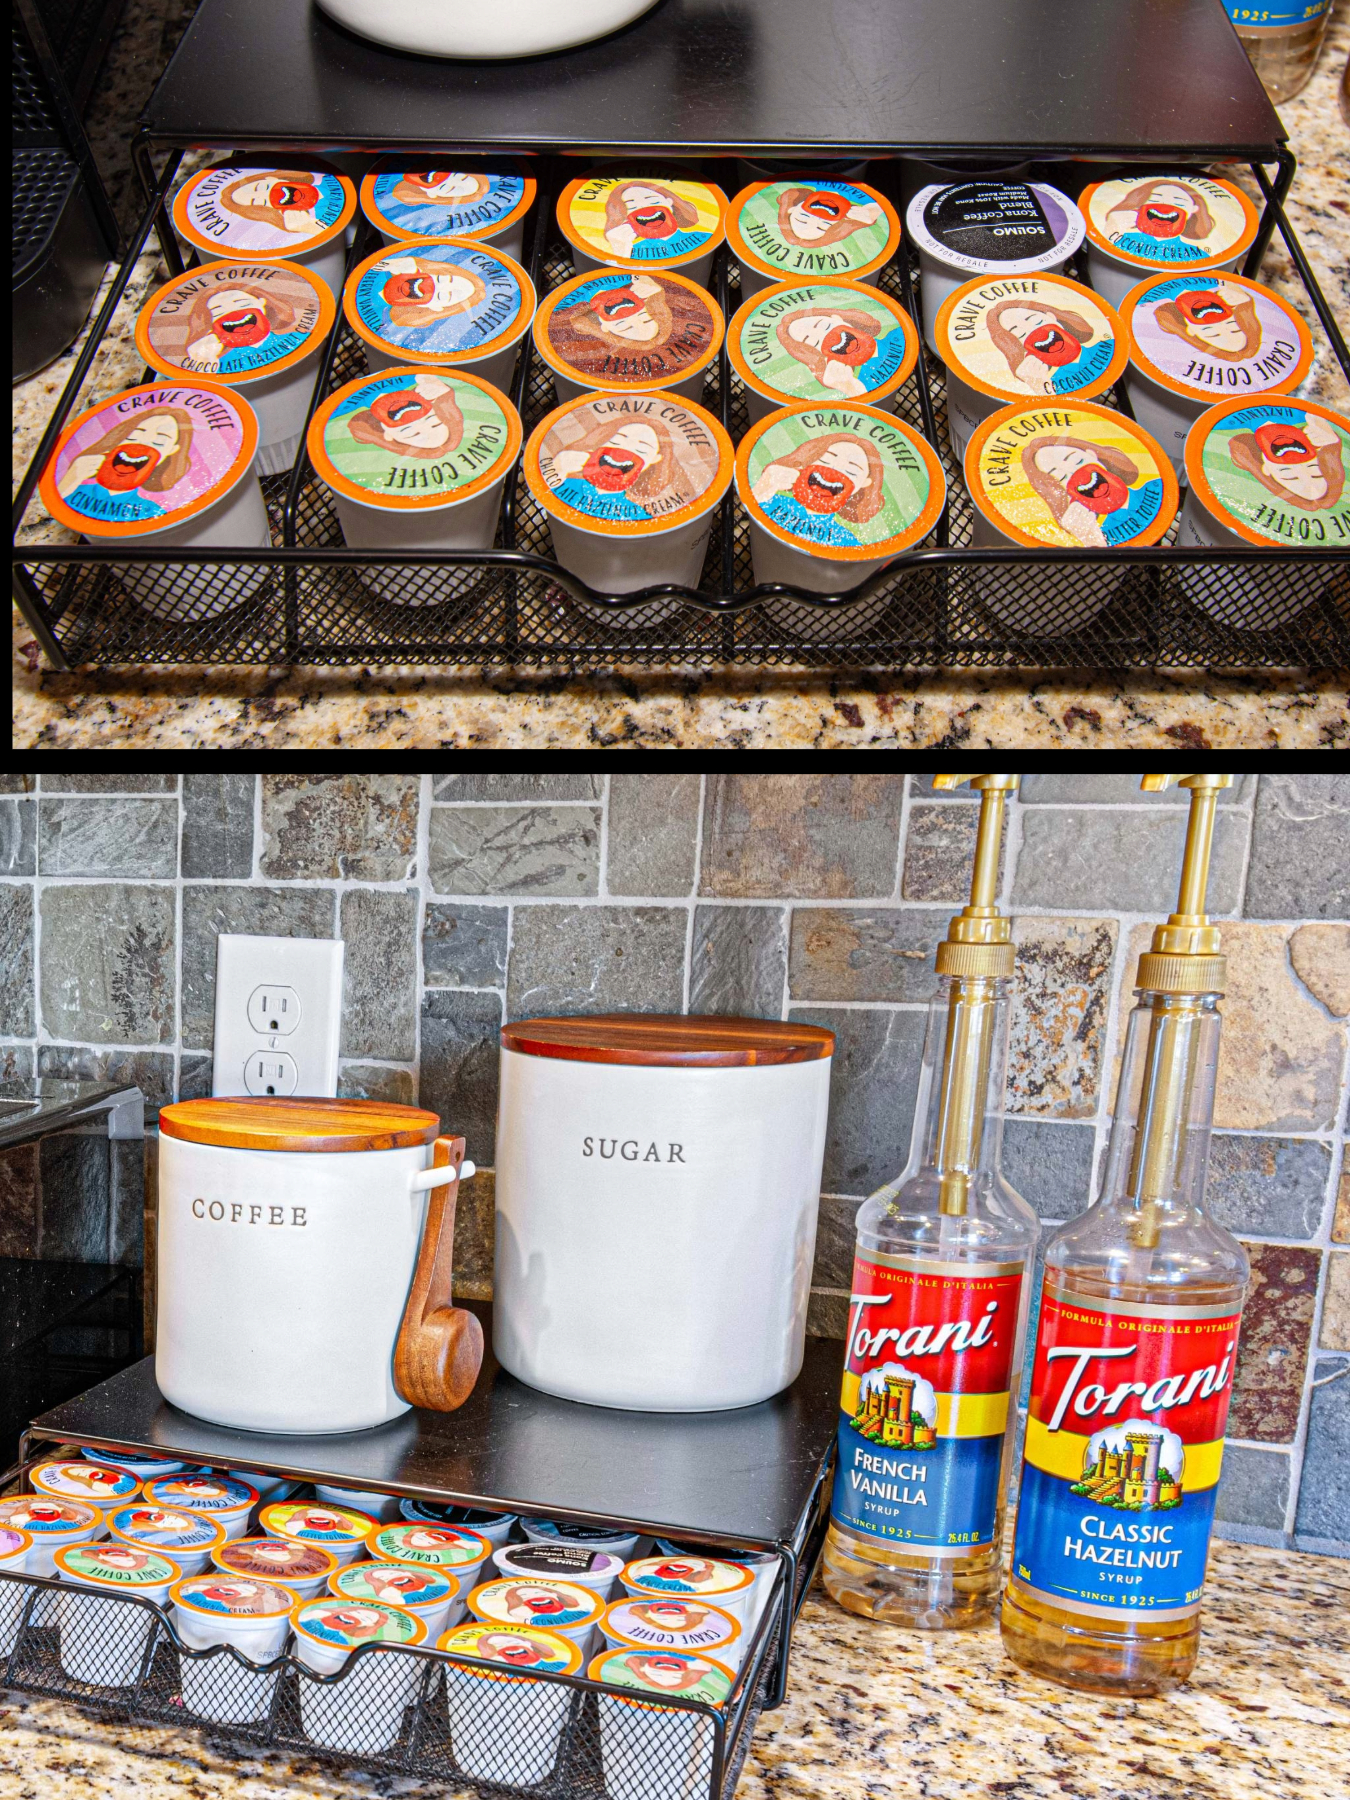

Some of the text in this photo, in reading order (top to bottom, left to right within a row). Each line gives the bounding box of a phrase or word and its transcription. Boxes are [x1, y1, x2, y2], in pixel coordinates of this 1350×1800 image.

[1232, 8, 1269, 21] 1925
[194, 166, 245, 238] CRAVE COFFEE
[577, 170, 620, 202] CRAVE
[1177, 177, 1231, 201] COFFEE
[446, 202, 502, 229] COFFEE
[629, 231, 703, 260] BUTTER TOFFEE
[746, 222, 850, 271] CRAVE COFFEE
[1107, 230, 1203, 260] COCONUT CREAM
[159, 267, 279, 315] CRAVE COFFEE
[469, 254, 513, 338] CRAVE COFFEE
[750, 288, 816, 366] CRAVE COFFEE
[954, 280, 1040, 343] CRAVE COFFEE
[248, 331, 298, 369] HAZELNUT
[295, 307, 317, 335] CREAM
[869, 334, 906, 387] HAZELNUT
[1044, 338, 1115, 397] COCONUT CREAM
[1184, 338, 1297, 388] CRAVE COFFEE
[344, 375, 406, 409] HAZELNUT
[116, 390, 235, 432] CRAVE COFFEE
[593, 400, 712, 449] CRAVE COFFEE
[1234, 406, 1294, 426] HAZELNUT
[384, 423, 502, 487] CRAVE COFFEE
[800, 413, 921, 474] CRAVE COFFEE
[988, 412, 1074, 487] CRAVE COFFEE
[69, 490, 141, 518] CINNAMON
[539, 456, 685, 519] CHOCOLATE HAZELNUT CREAM
[768, 505, 834, 544] HAZELNUT
[1136, 489, 1161, 525] TOFFEE
[1250, 503, 1326, 541] COFFEE
[581, 1136, 687, 1164] SUGAR
[191, 1197, 309, 1228] COFFEE
[879, 1272, 939, 1288] ORIGINALE
[844, 1293, 998, 1372] Torani
[1061, 1310, 1235, 1335] FORMULA ORIGINALE D'ITALIA
[1046, 1340, 1235, 1433] Torani
[854, 1447, 928, 1483] FRENCH
[850, 1469, 928, 1507] VANILLA
[864, 1501, 900, 1517] SYRUP
[852, 1517, 913, 1540] SINCE 1925
[1080, 1515, 1174, 1545] CLASSIC
[1064, 1536, 1183, 1570] HAZELNUT
[86, 1566, 168, 1582] CRAVE COFFEE
[1099, 1571, 1143, 1585] SYRUP
[1080, 1590, 1156, 1607] SINCE 1925
[627, 1626, 721, 1644] CRAVE COFFEE
